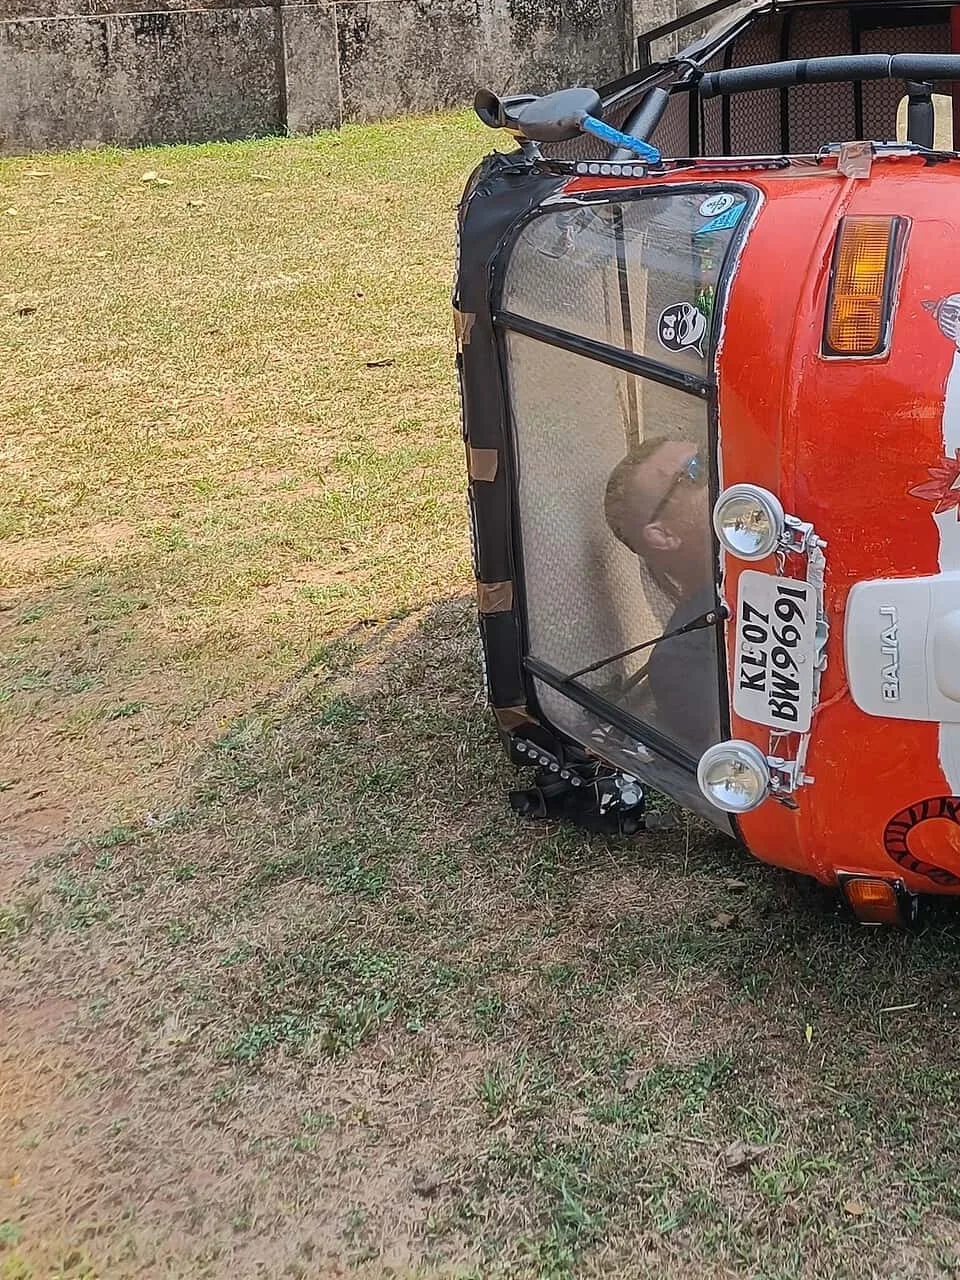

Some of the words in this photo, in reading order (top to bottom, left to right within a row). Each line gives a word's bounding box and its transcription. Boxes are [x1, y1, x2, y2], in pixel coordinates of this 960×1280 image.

[662, 314, 677, 340] 64
[742, 600, 770, 644] 07
[880, 604, 900, 703] BAJAJ
